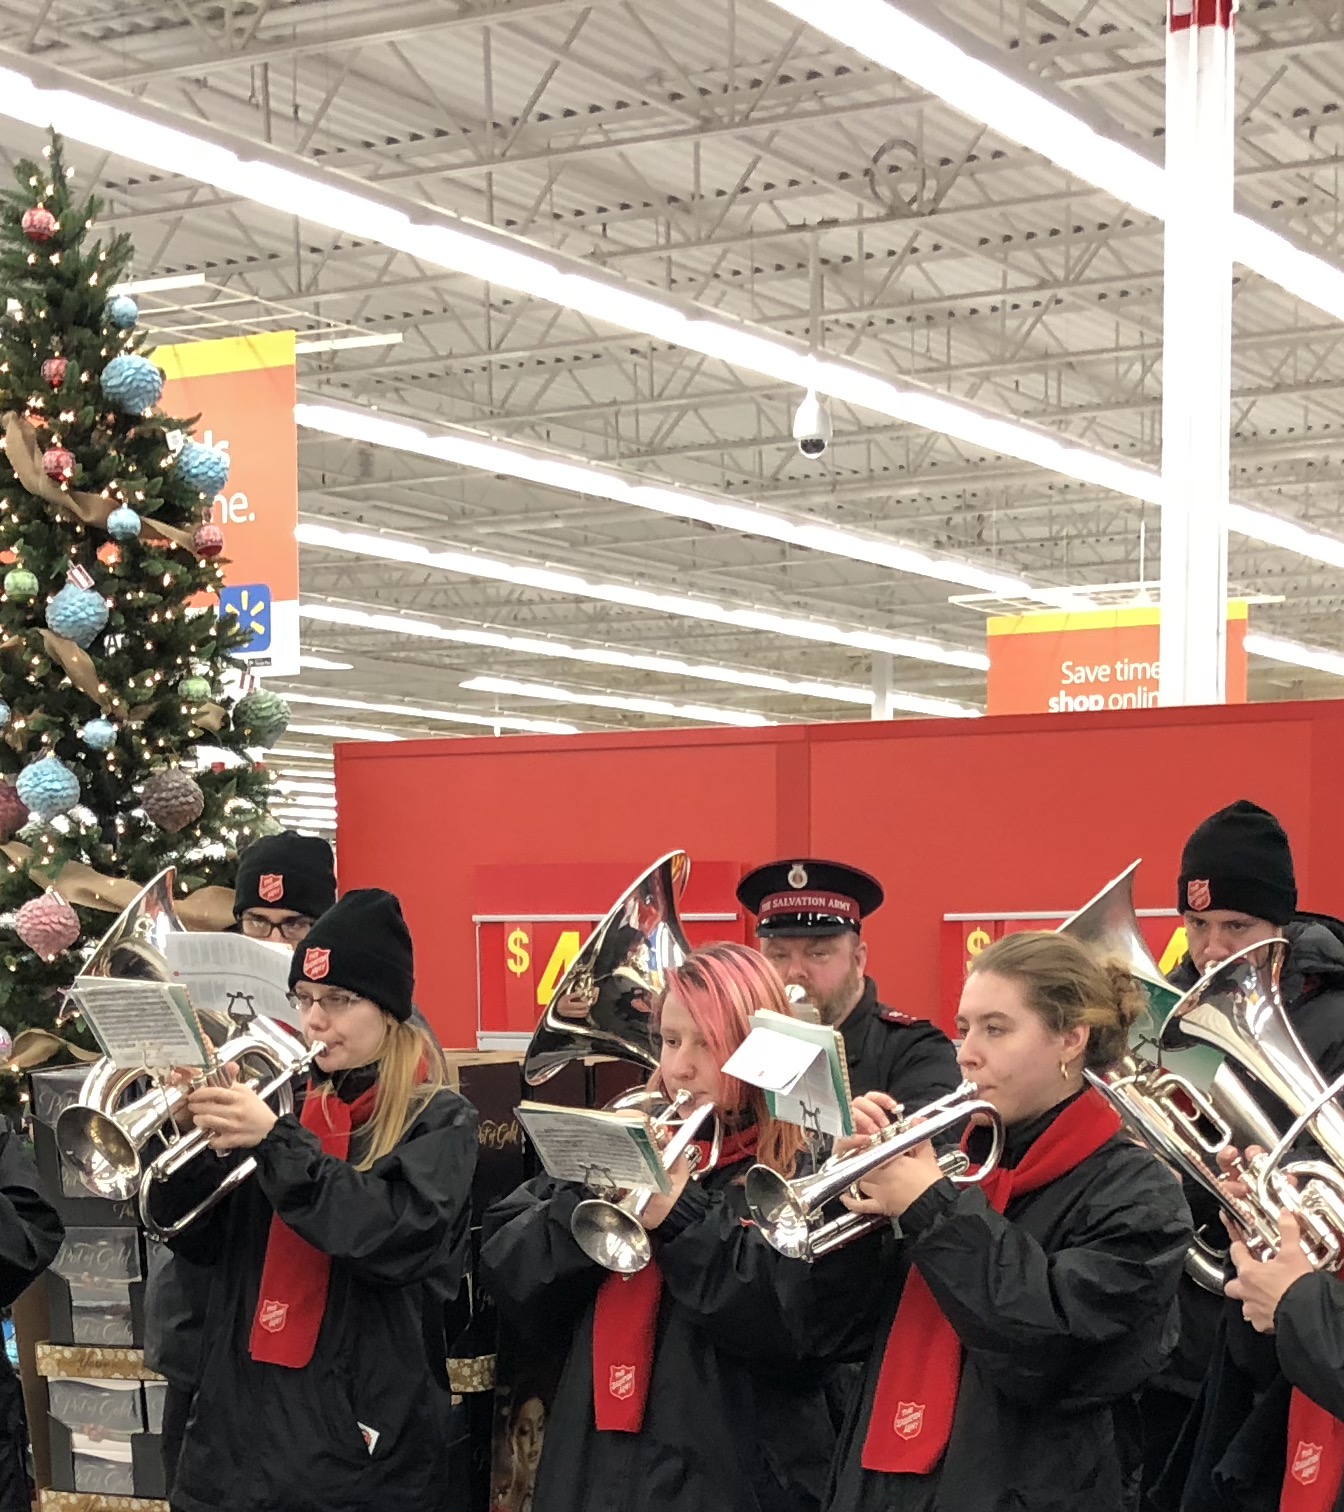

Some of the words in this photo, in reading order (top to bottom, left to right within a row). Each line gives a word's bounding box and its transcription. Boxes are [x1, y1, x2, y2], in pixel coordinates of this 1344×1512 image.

[1061, 661, 1111, 684] Save
[1115, 658, 1161, 682] time
[1048, 690, 1105, 713] shop
[772, 896, 826, 909] SALVATION
[827, 899, 851, 912] ARMY
